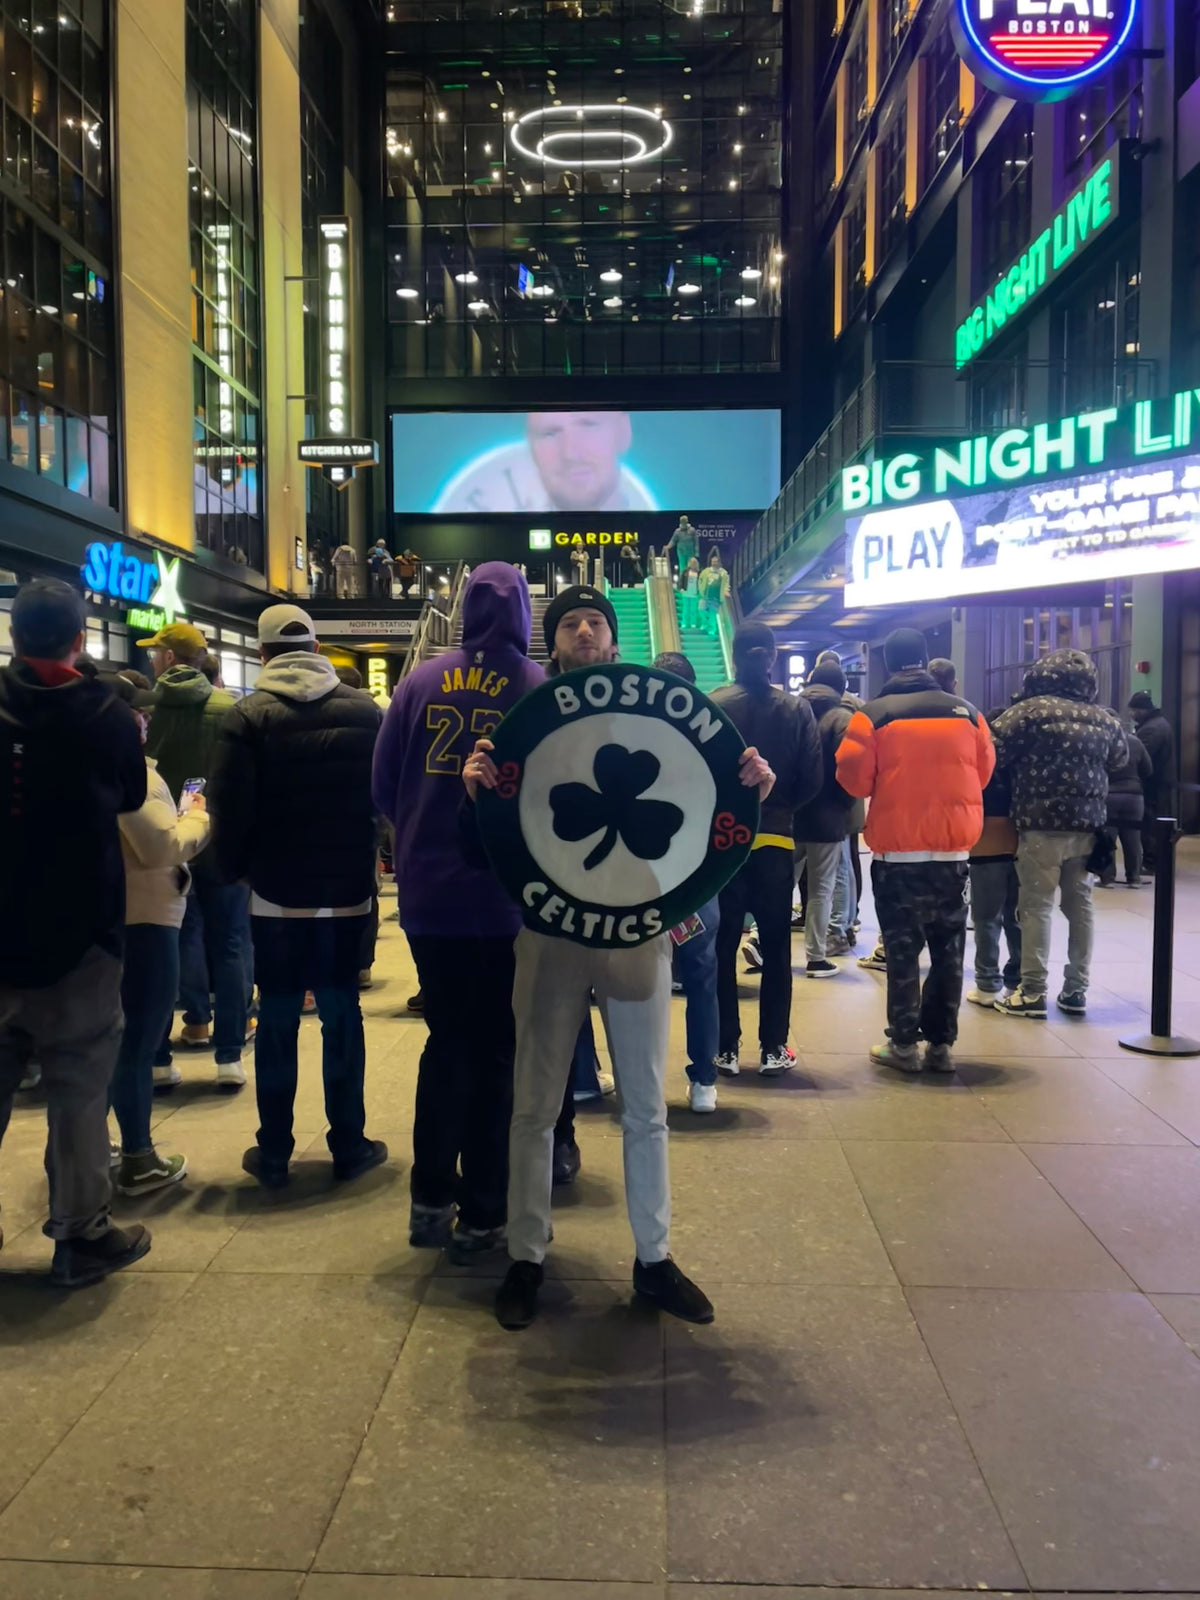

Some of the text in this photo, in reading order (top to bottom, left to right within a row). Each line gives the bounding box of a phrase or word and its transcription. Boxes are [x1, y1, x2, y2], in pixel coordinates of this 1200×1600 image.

[1008, 20, 1090, 34] BOSTON
[986, 228, 1051, 339] NIGHT
[1053, 159, 1111, 270] LIVE
[352, 446, 372, 456] TAP
[842, 387, 1200, 511] BIG NIGHT LI
[1029, 483, 1107, 514] YOUR
[555, 532, 639, 544] GARDEN
[696, 529, 736, 538] SOCIETY
[863, 520, 953, 580] PLAY
[349, 621, 412, 629] NORTH STATION
[441, 667, 509, 697] JAMES
[554, 674, 724, 744] BOSTON
[522, 881, 663, 944] CELTICS
